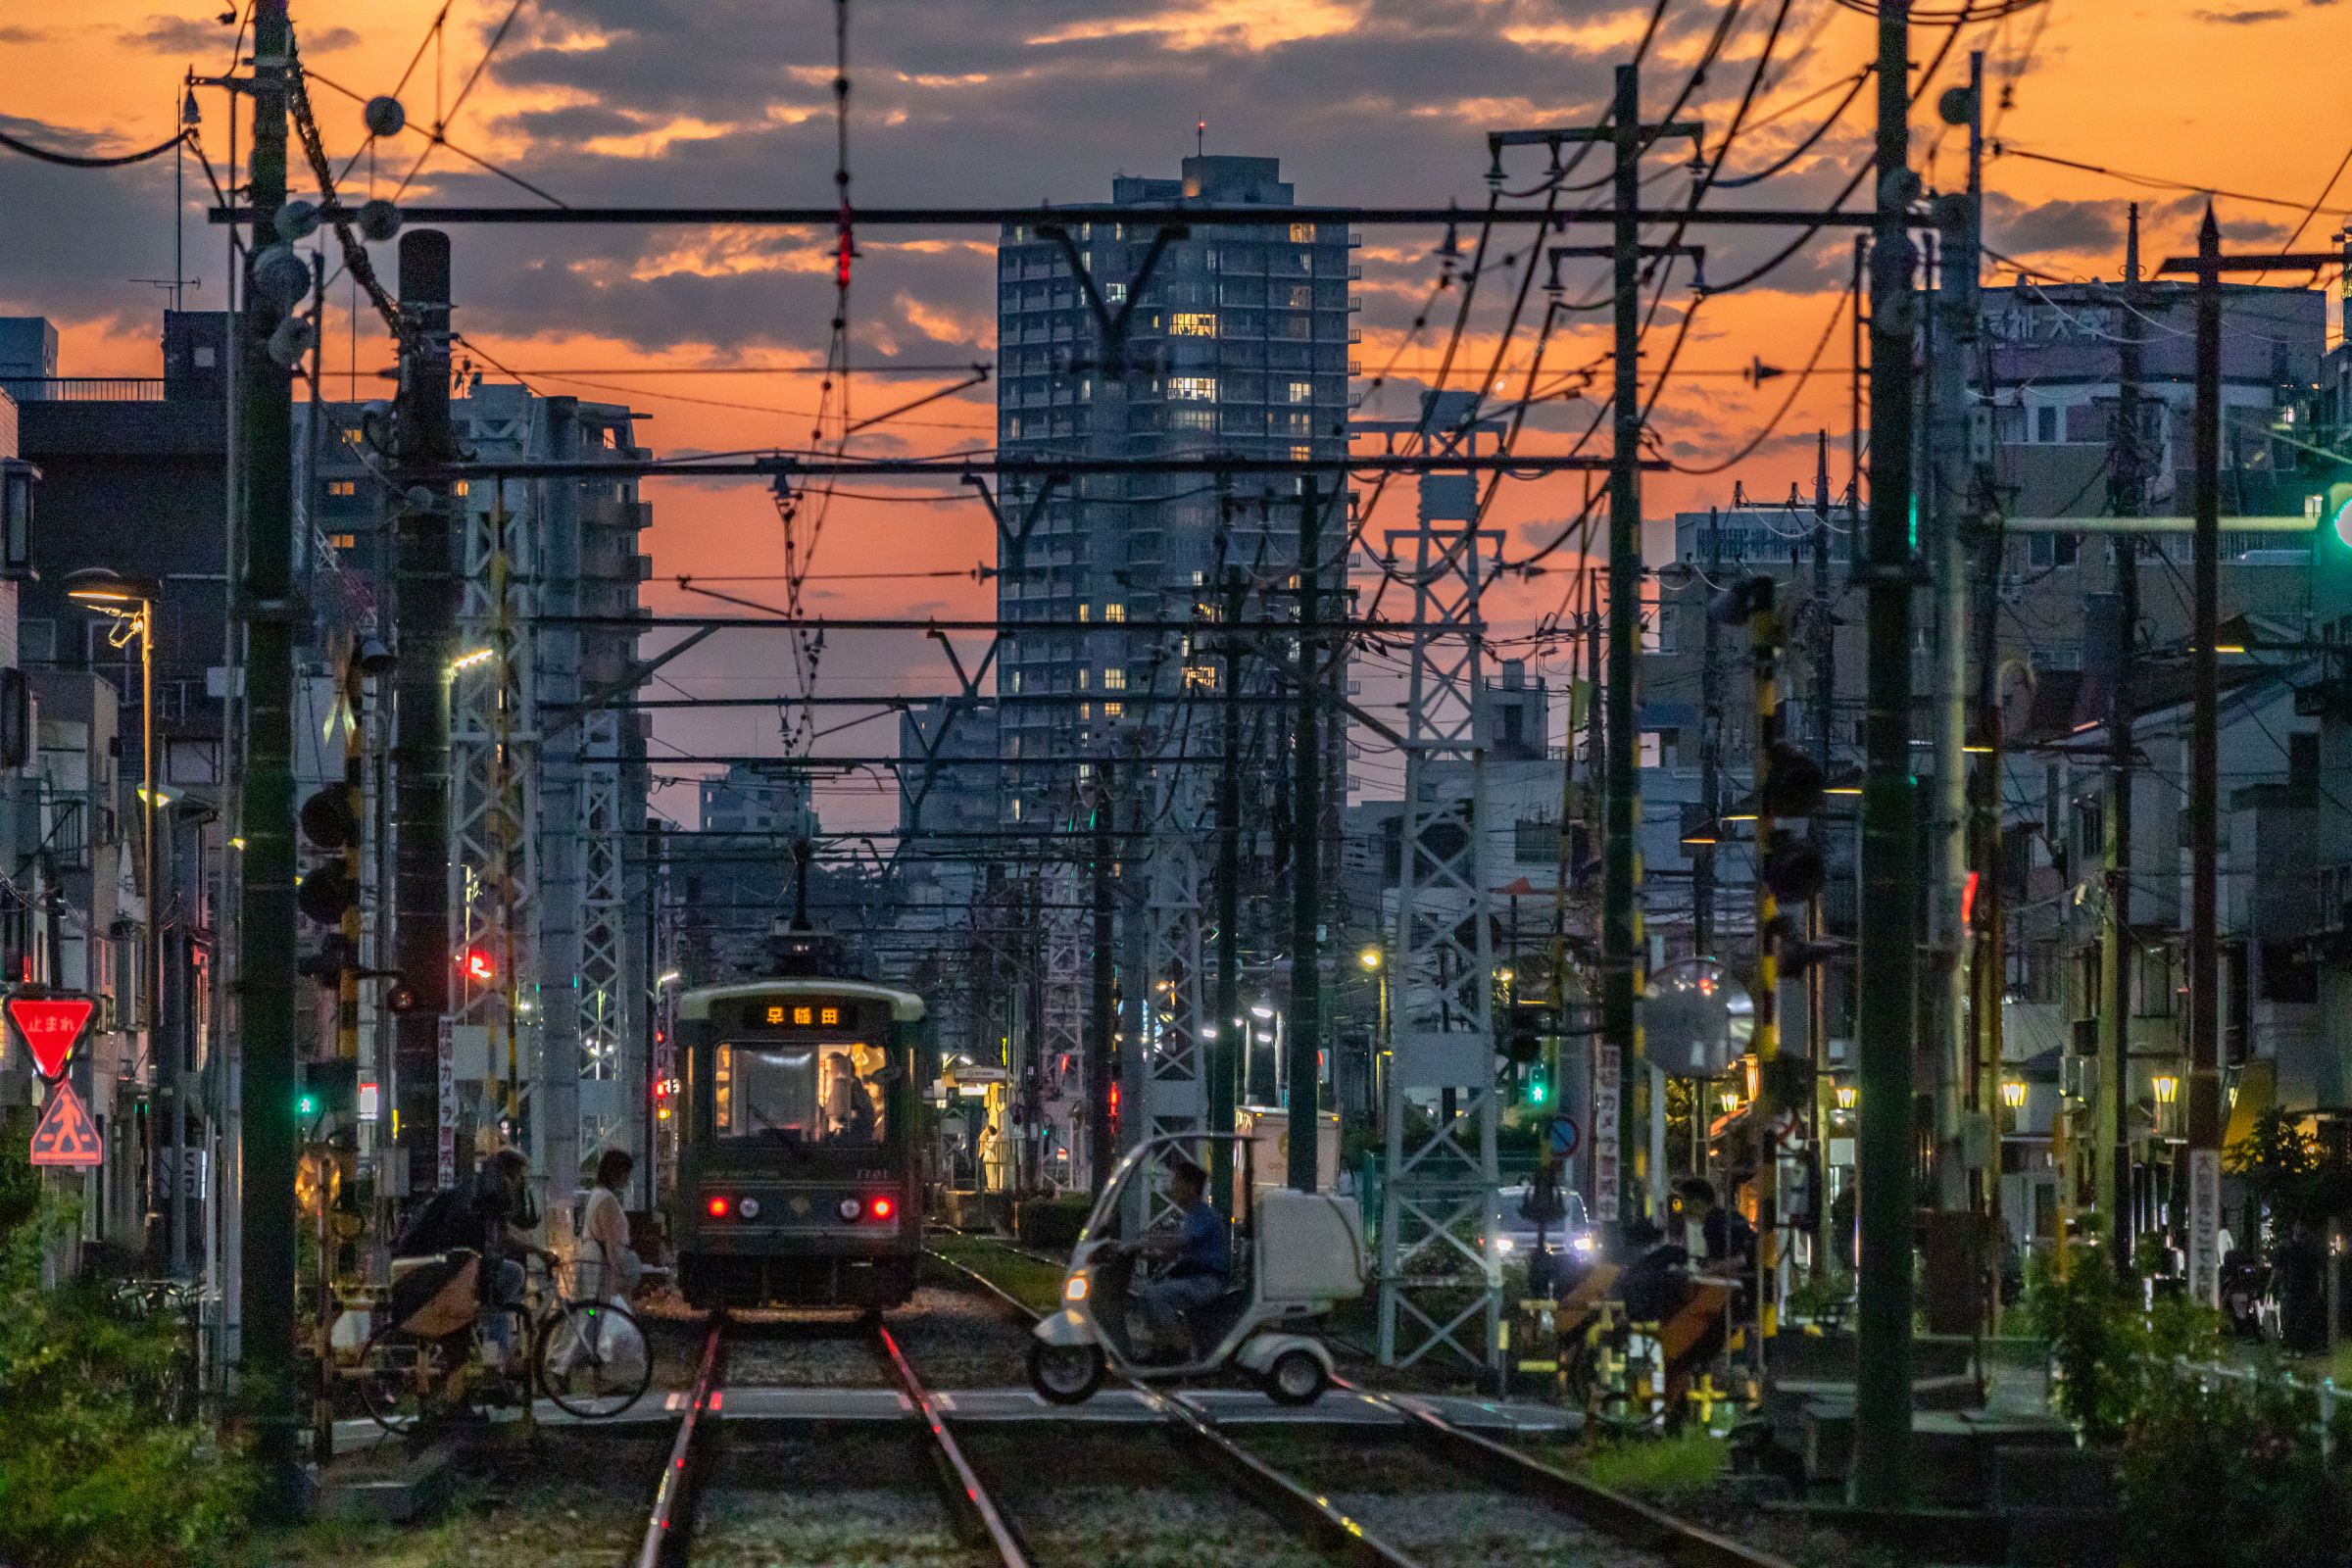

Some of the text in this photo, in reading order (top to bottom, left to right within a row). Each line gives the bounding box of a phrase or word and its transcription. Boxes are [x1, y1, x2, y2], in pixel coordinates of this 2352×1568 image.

[27, 1015, 75, 1033] 止まれ
[767, 1006, 839, 1025] 早稲田
